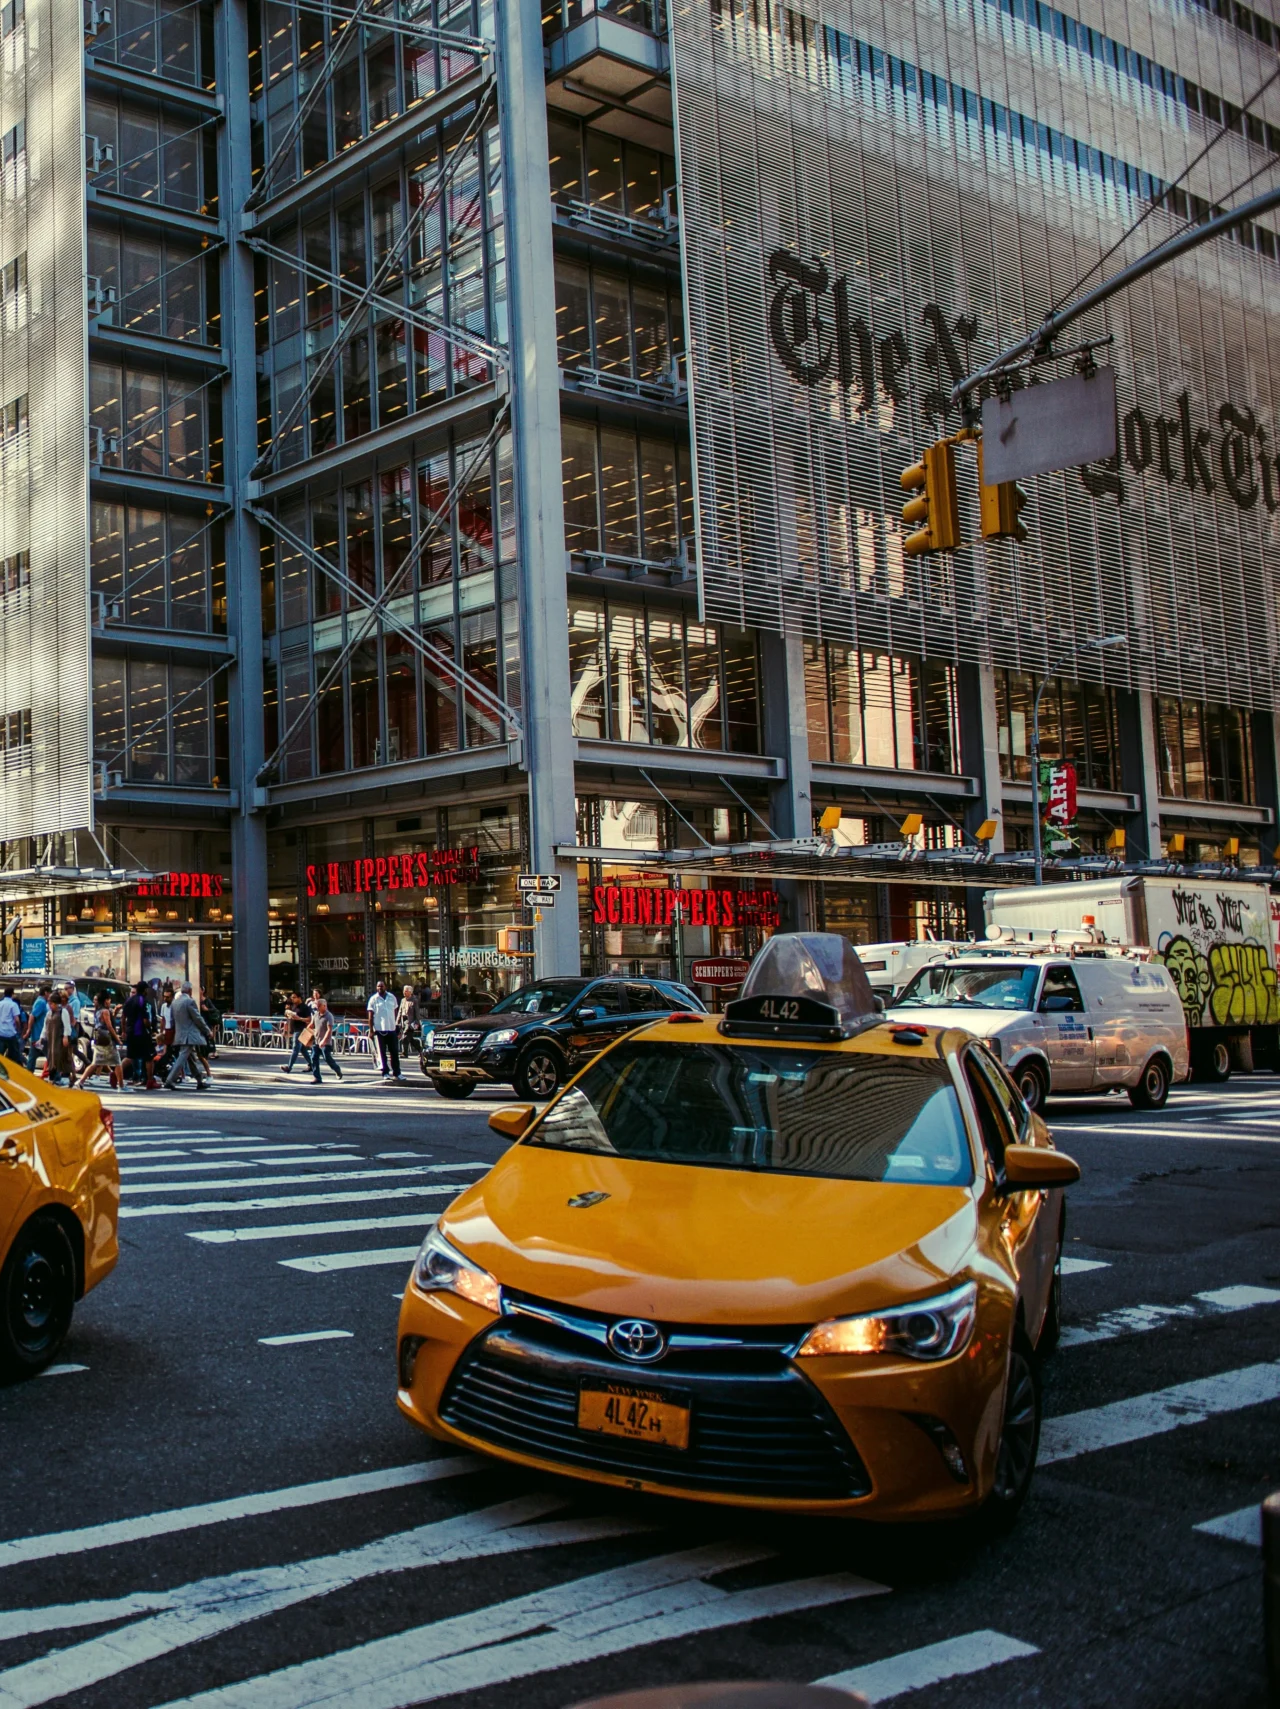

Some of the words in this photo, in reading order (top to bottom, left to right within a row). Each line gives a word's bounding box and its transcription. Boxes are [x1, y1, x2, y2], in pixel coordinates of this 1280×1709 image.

[769, 249, 911, 413] The
[1219, 402, 1280, 513] Ti
[1049, 767, 1068, 820] ART
[523, 879, 536, 887] ONE
[541, 879, 554, 887] WAY
[593, 885, 734, 927] SCHNIPPER'S
[318, 957, 350, 970] SALADS
[695, 966, 734, 978] SCHNIPPER'S
[760, 1000, 800, 1020] 4L42
